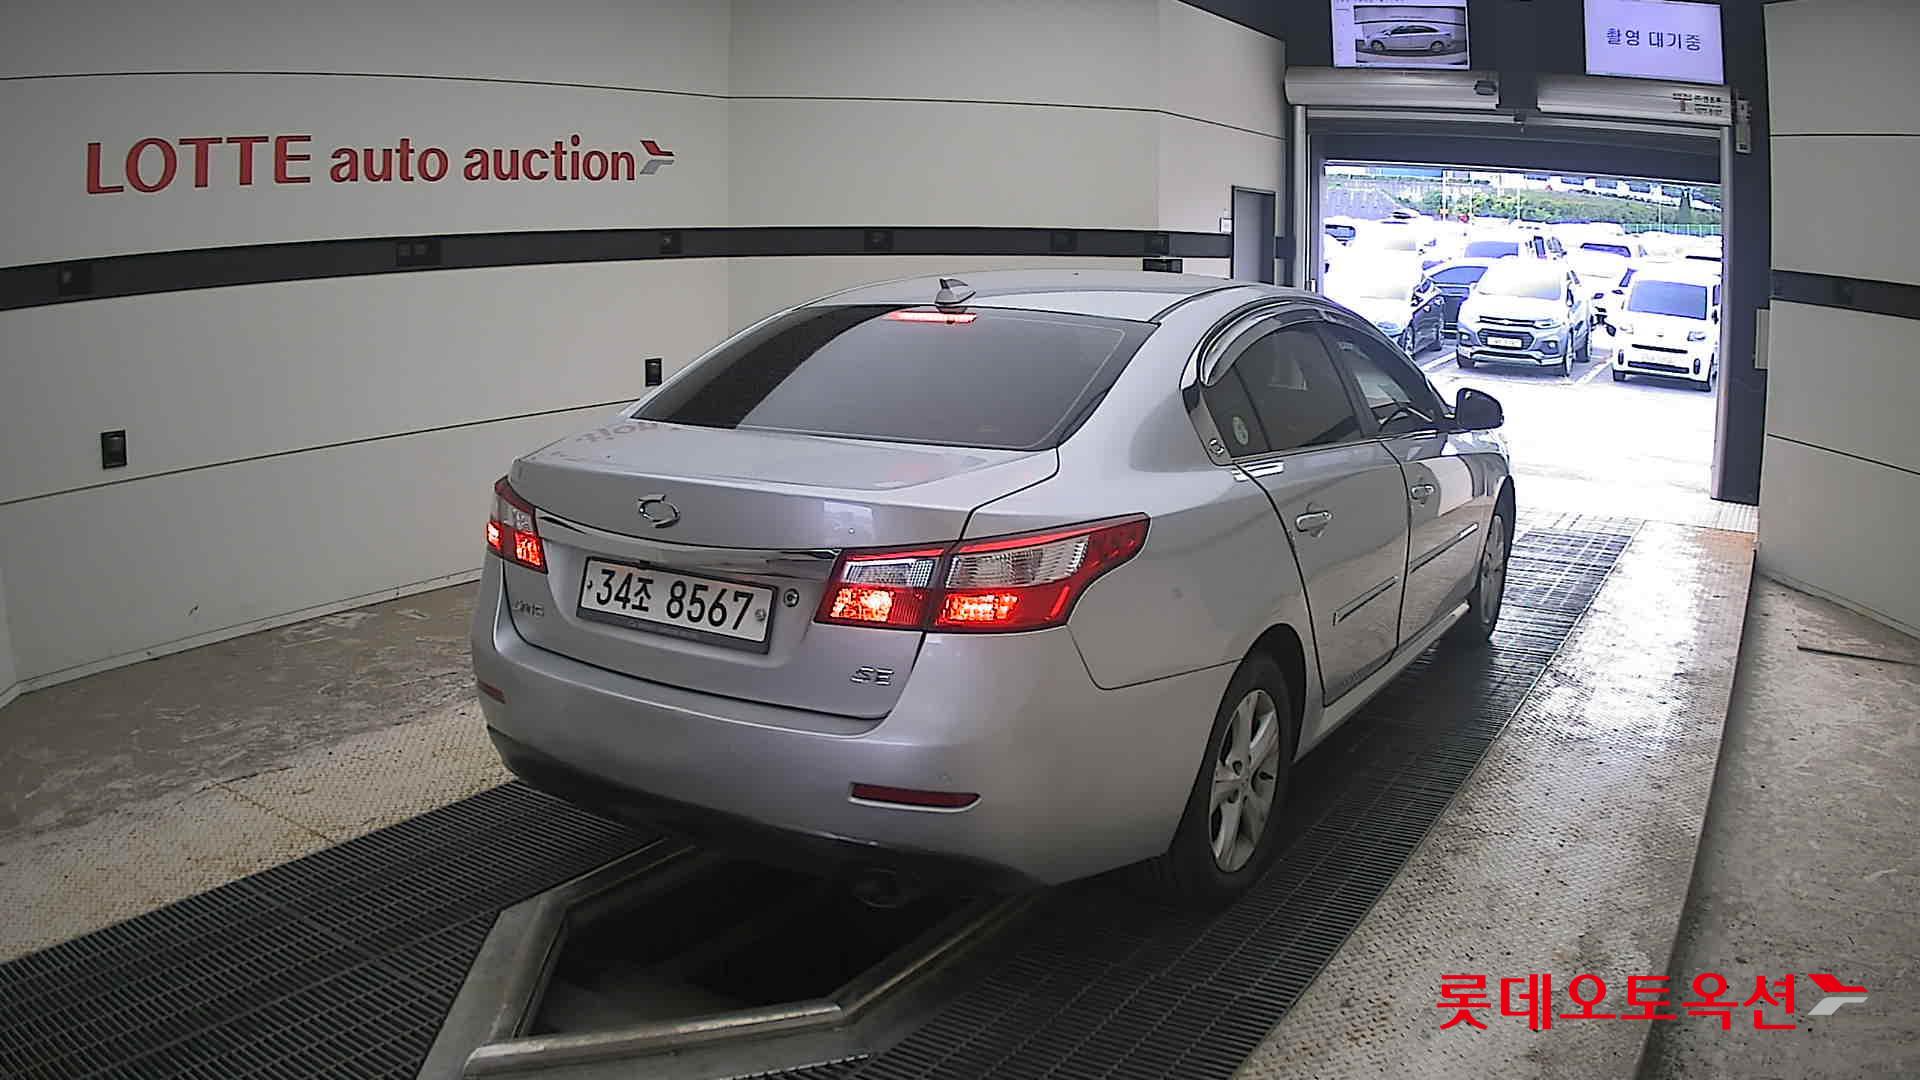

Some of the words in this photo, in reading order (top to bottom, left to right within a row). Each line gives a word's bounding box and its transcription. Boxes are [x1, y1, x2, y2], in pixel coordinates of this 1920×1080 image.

[1648, 31, 1701, 51] 대기중
[87, 135, 312, 194] LOTTE
[330, 139, 449, 183] auto
[464, 134, 636, 181] auction
[596, 569, 654, 612] 34조
[666, 580, 754, 630] 8567
